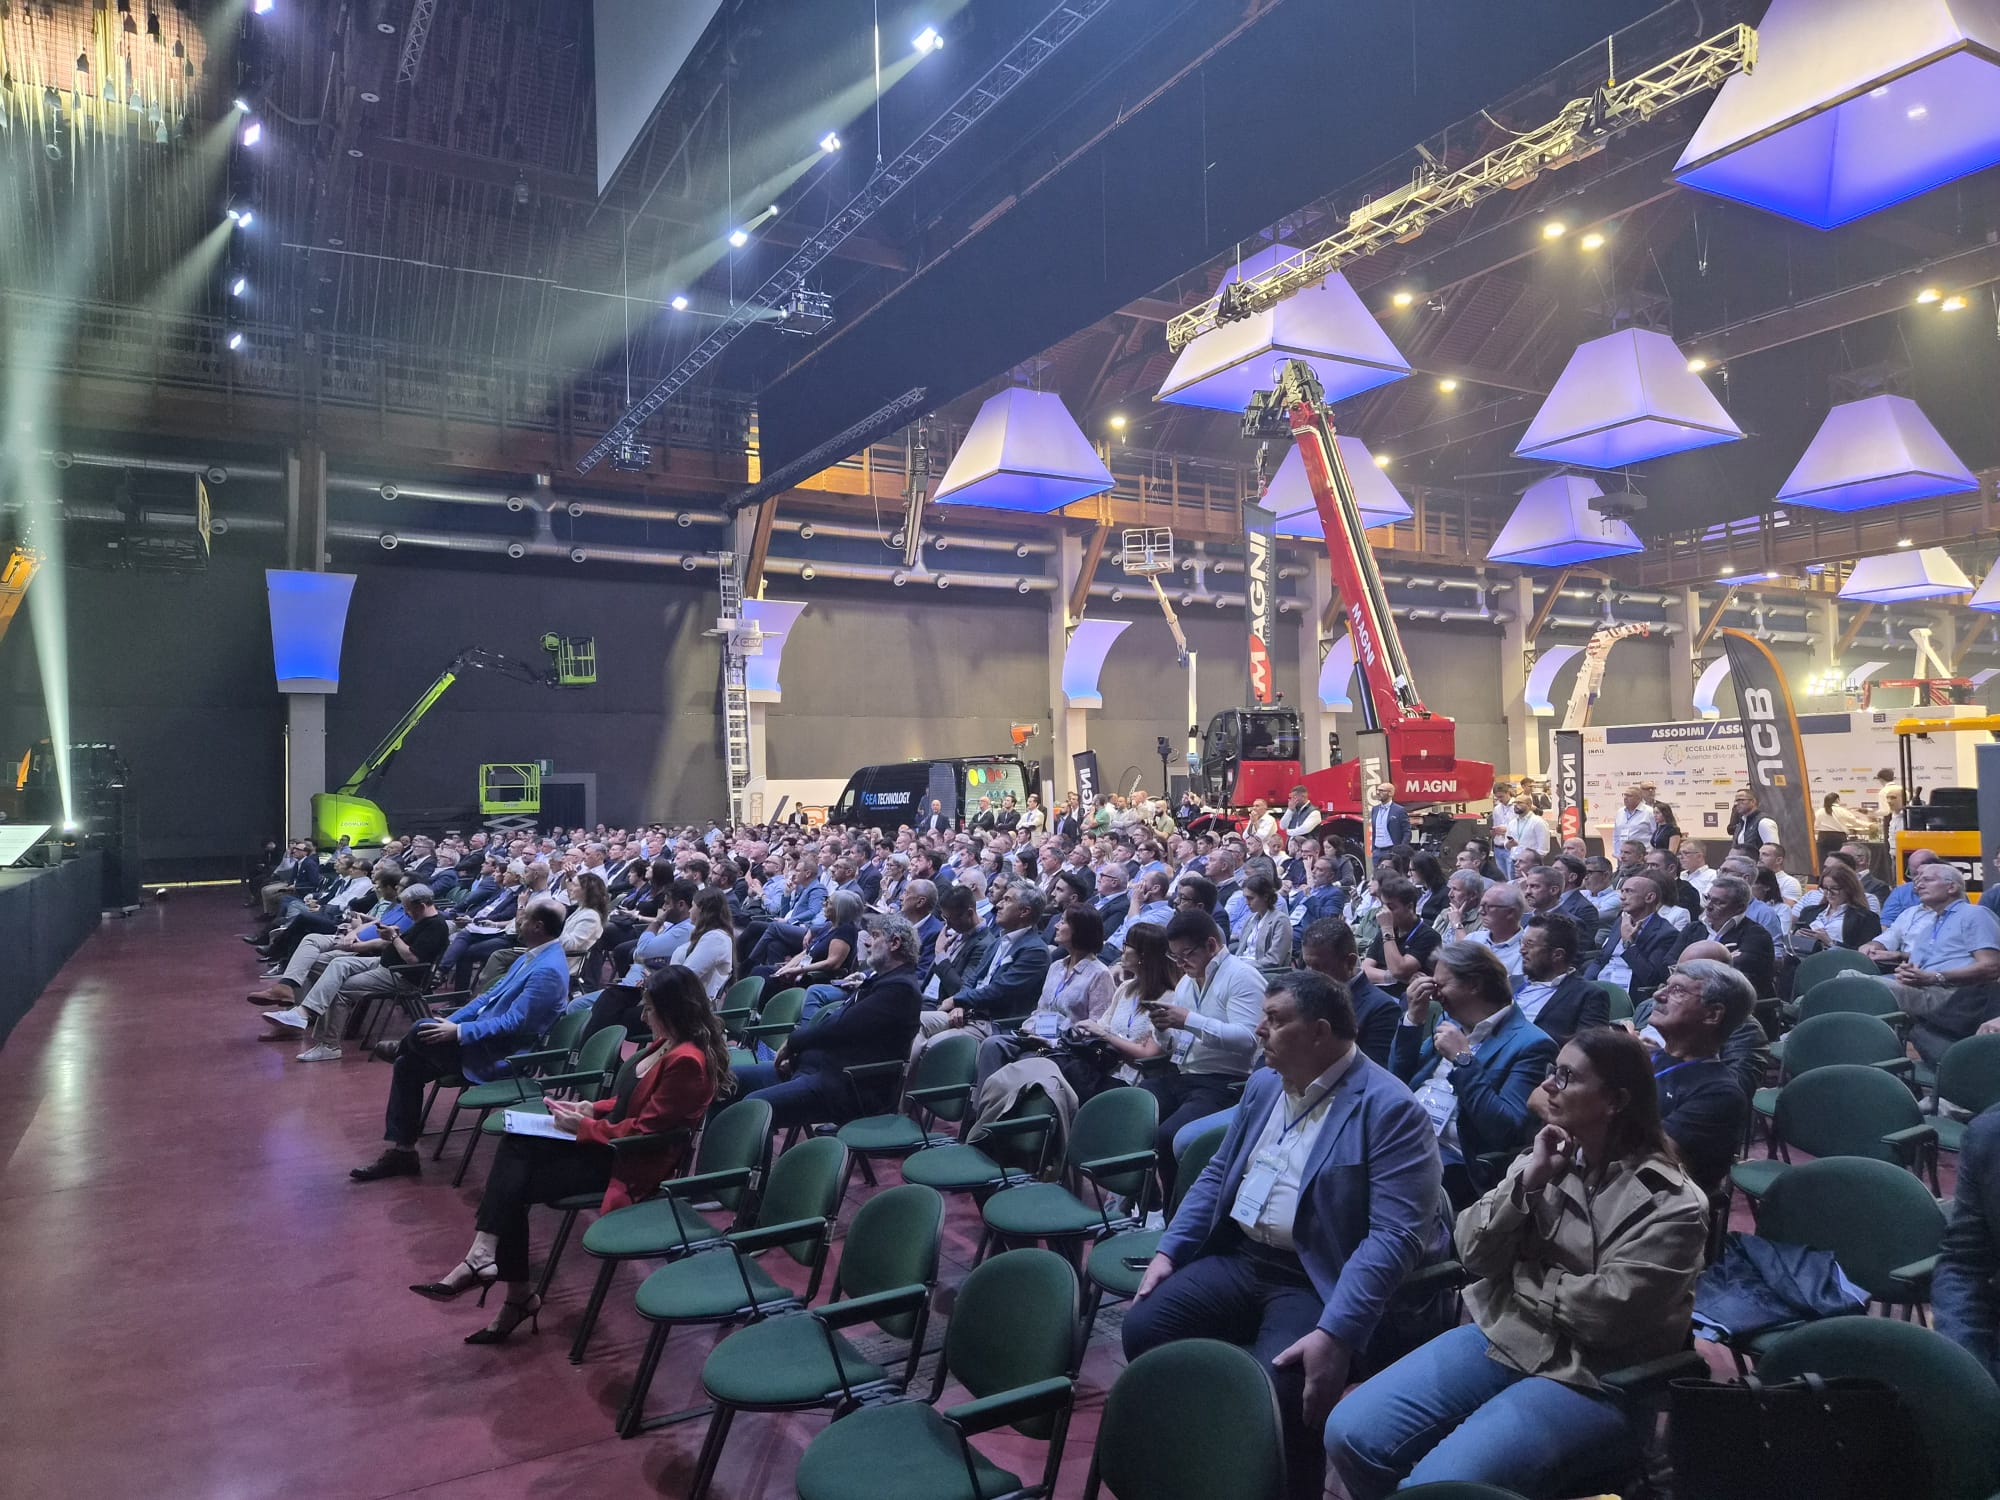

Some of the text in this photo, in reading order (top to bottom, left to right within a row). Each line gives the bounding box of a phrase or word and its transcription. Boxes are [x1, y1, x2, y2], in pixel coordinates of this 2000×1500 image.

[1250, 531, 1266, 692] MAGNI
[1352, 602, 1375, 667] MAGNI
[1651, 726, 1705, 738] ASSODIMI
[1745, 687, 1783, 787] JCB
[1405, 780, 1457, 793] MAGNI
[1562, 753, 1577, 837] MAGNI
